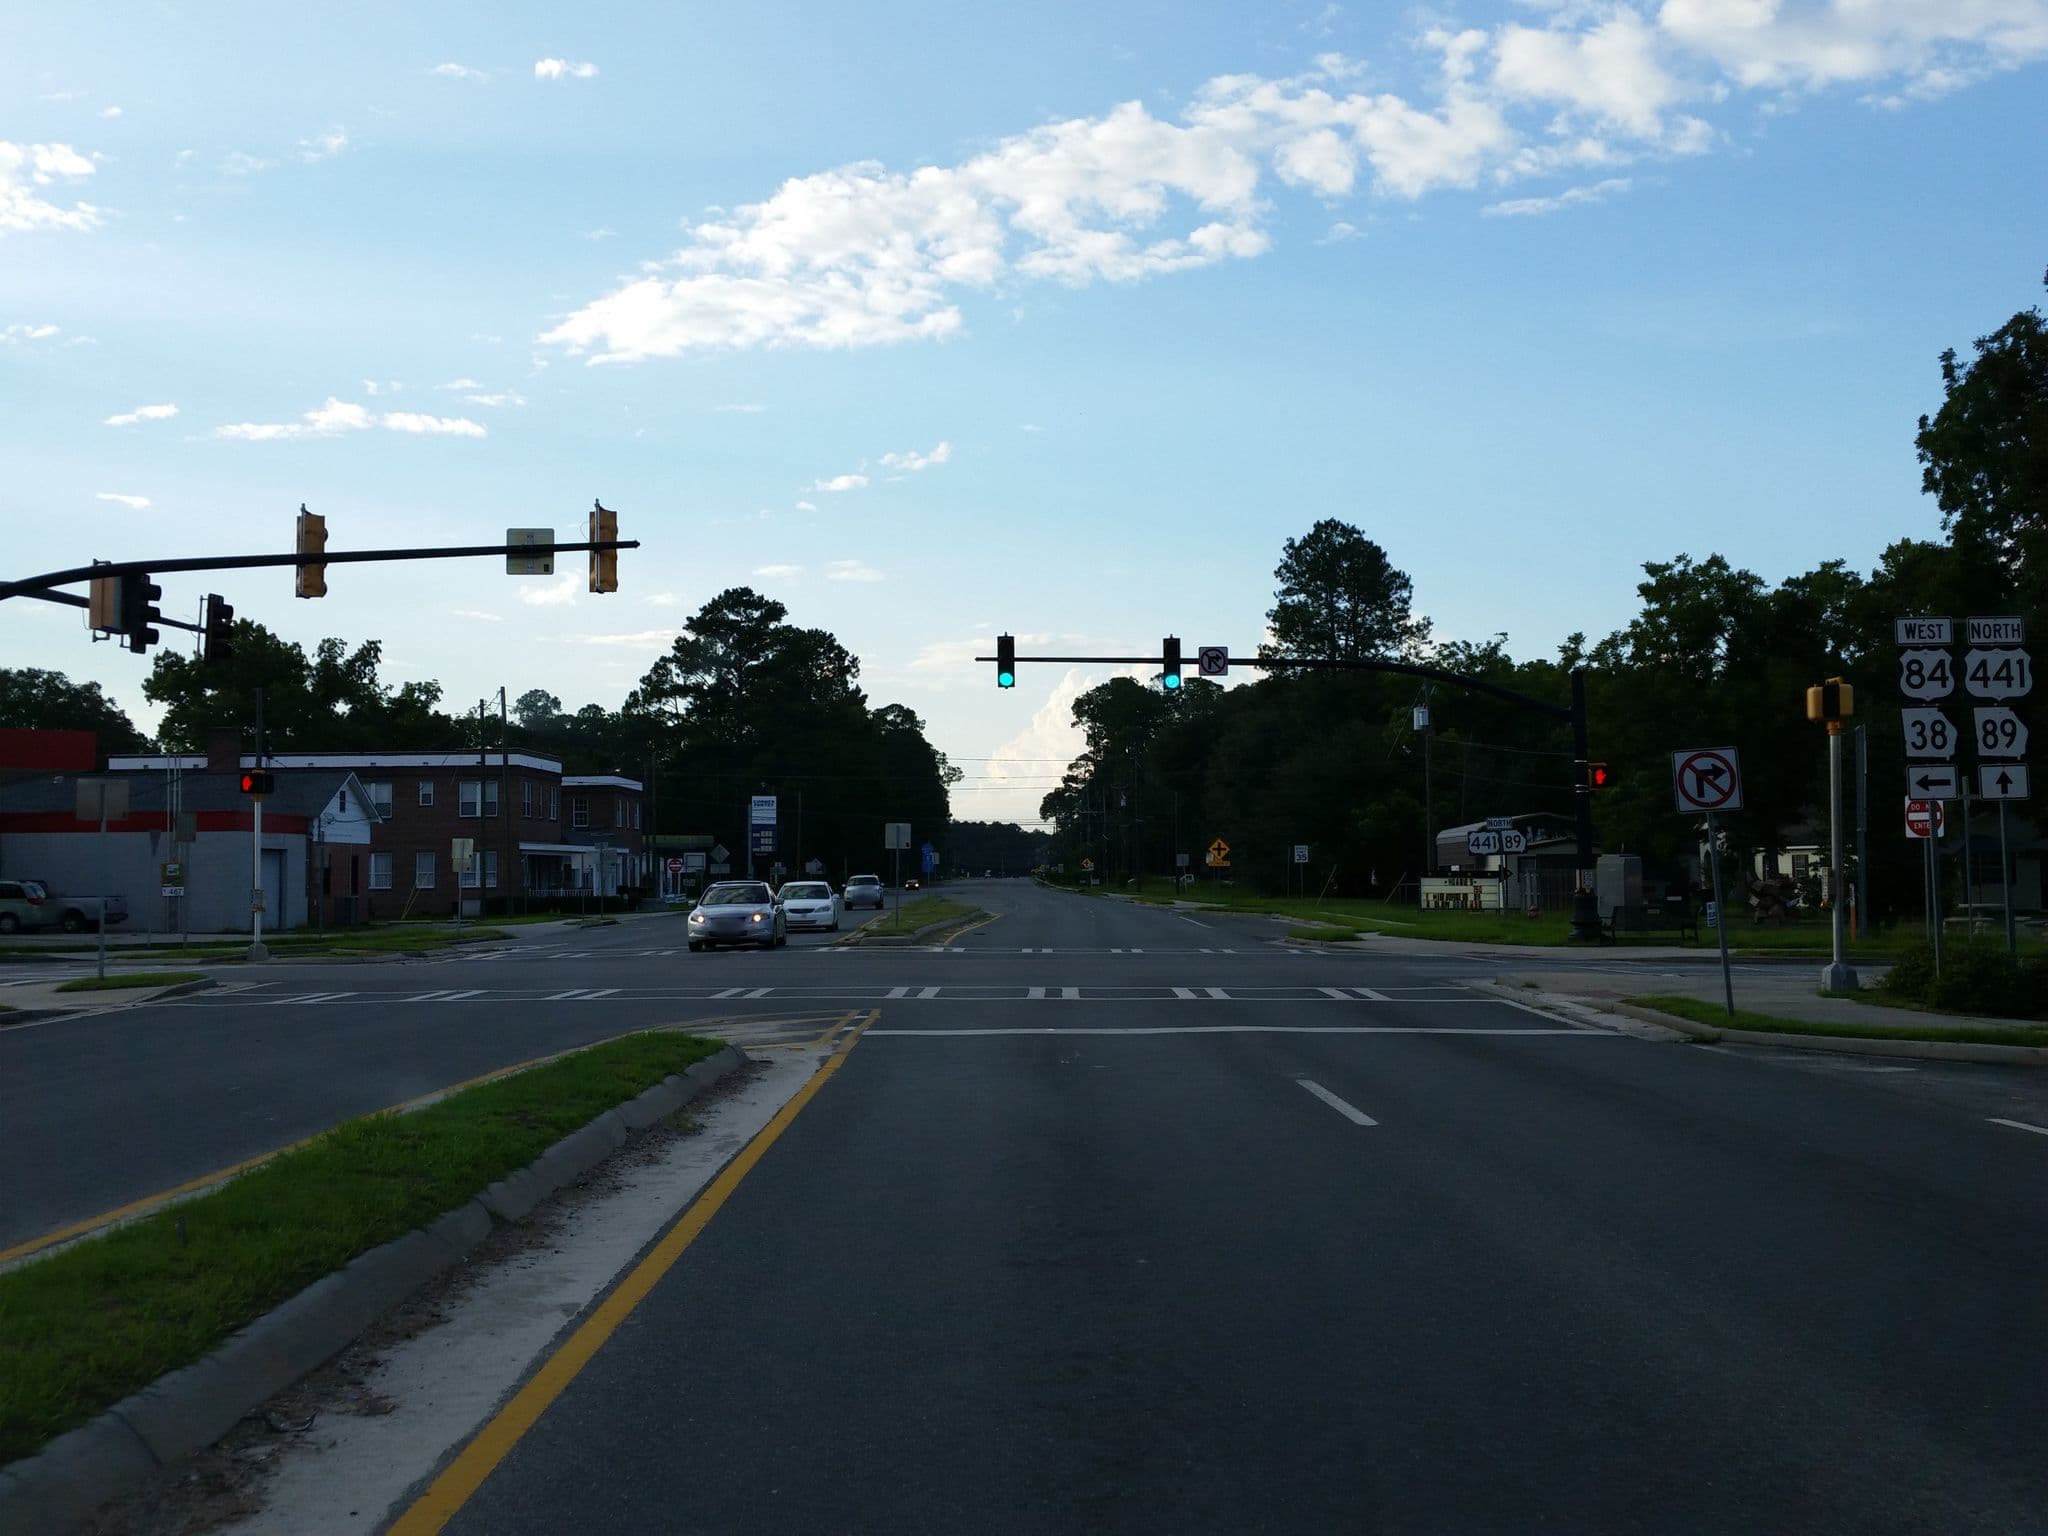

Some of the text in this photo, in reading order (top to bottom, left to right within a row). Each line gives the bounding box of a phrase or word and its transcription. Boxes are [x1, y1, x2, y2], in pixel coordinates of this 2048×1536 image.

[1904, 623, 1944, 640] WEST
[1971, 622, 2021, 639] NORTH
[1905, 659, 1949, 689] 84
[1969, 658, 2025, 688] 441
[1911, 720, 1948, 750] 38
[1982, 719, 2017, 749] 89
[1910, 803, 1921, 811] DO
[1488, 819, 1511, 827] NORTH
[1470, 836, 1497, 849] 441
[1505, 835, 1521, 848] 89
